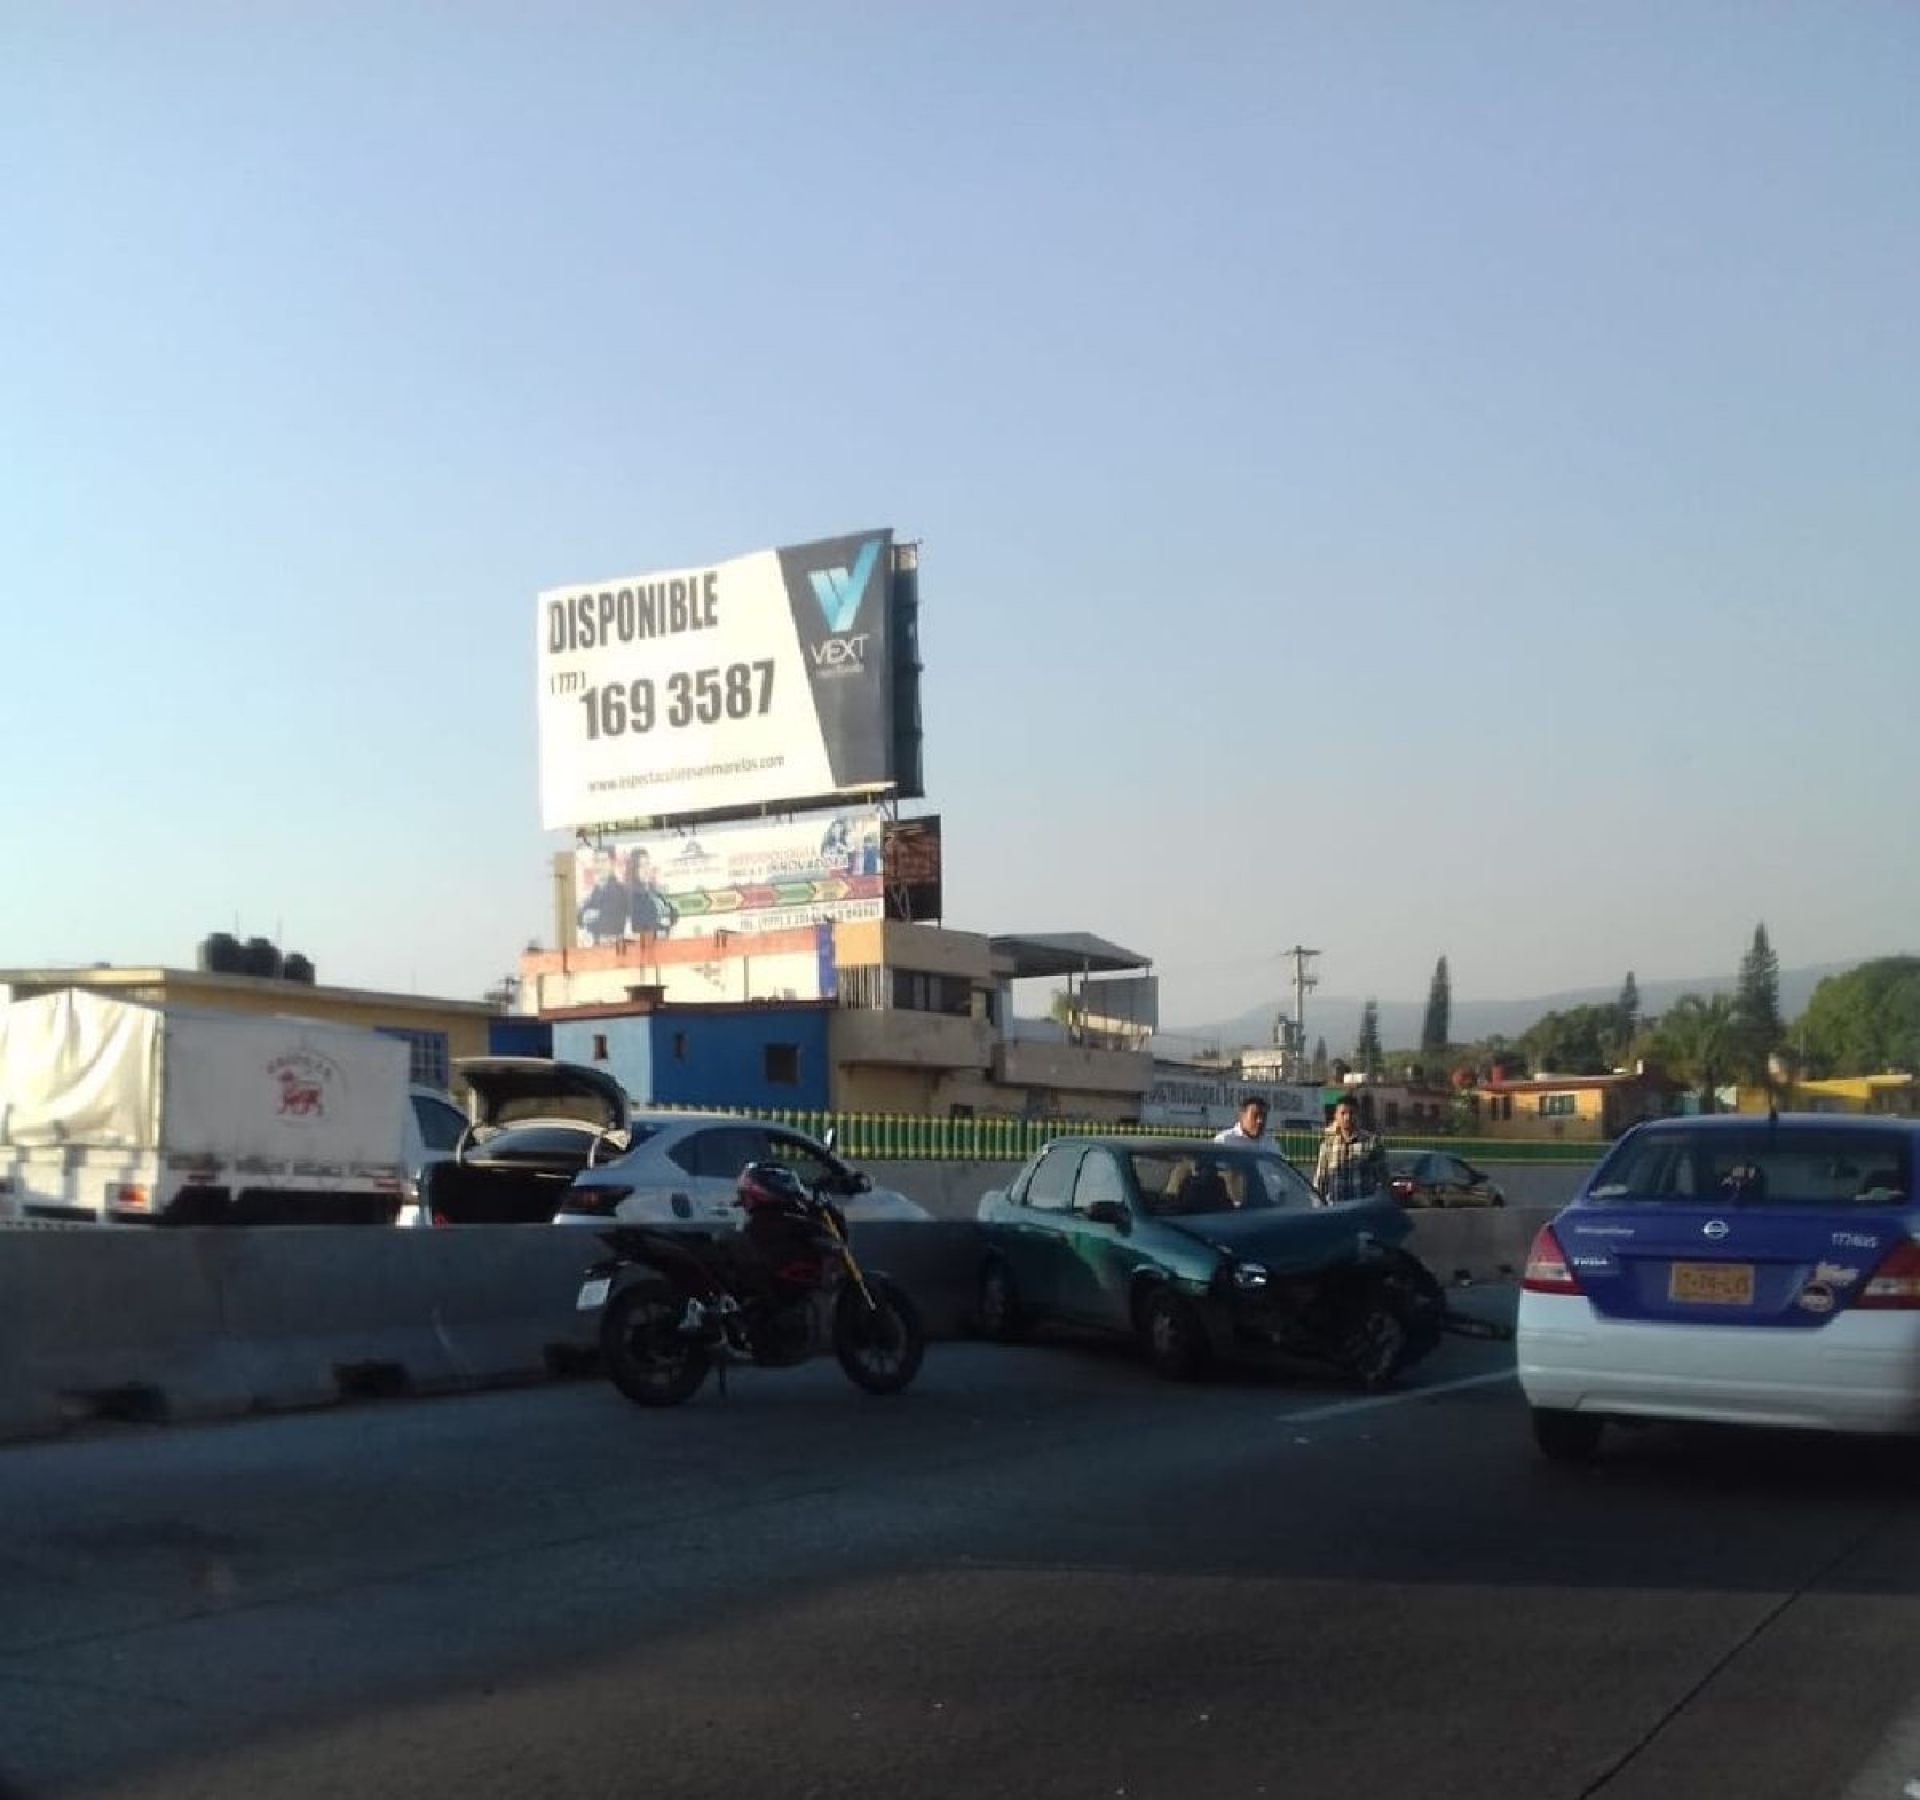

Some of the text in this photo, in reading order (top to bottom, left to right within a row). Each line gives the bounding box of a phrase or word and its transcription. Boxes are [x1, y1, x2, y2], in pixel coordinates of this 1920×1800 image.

[549, 572, 718, 653] DISPONIBLE
[811, 634, 869, 663] VEXT
[580, 658, 775, 739] 169 3587
